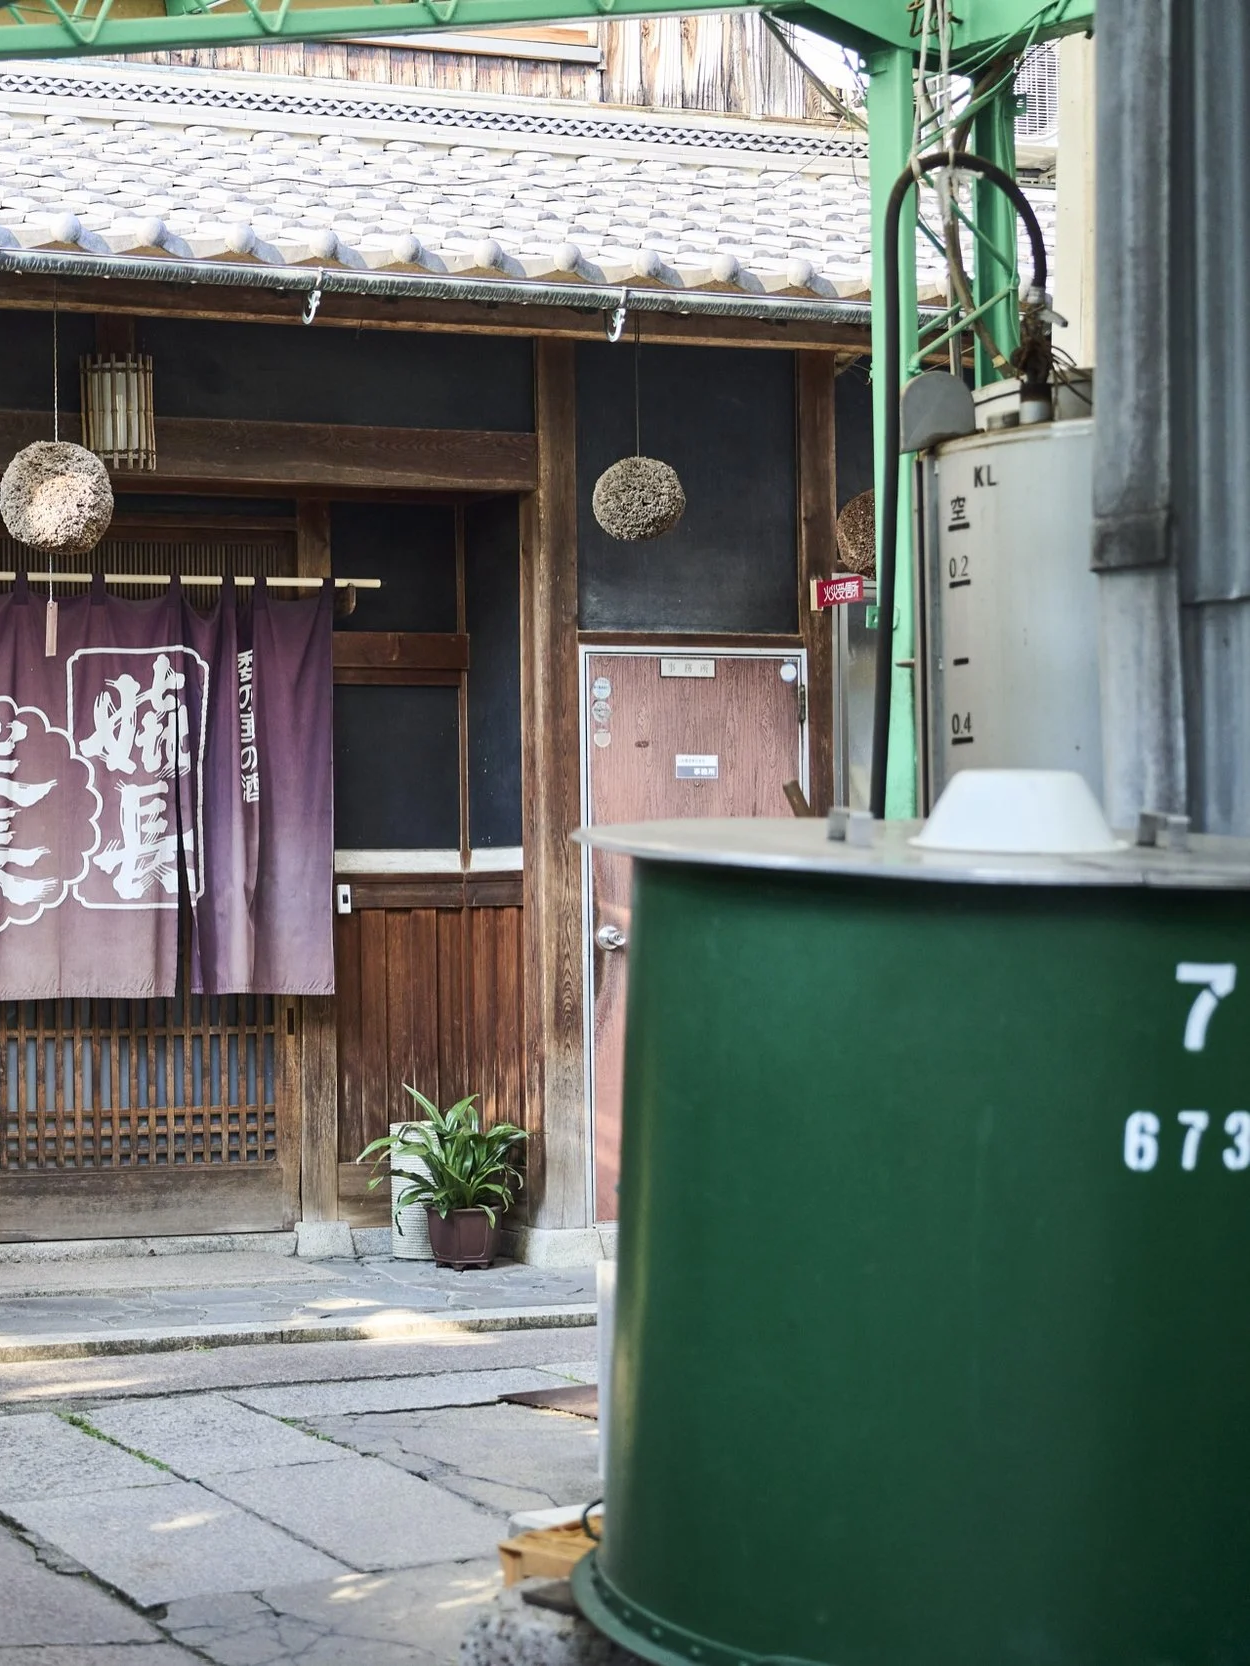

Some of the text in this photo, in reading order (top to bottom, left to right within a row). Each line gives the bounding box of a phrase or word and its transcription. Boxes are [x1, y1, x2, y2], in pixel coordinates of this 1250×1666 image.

[973, 464, 997, 488] KL
[950, 496, 966, 521] 空
[1175, 961, 1237, 1052] 7
